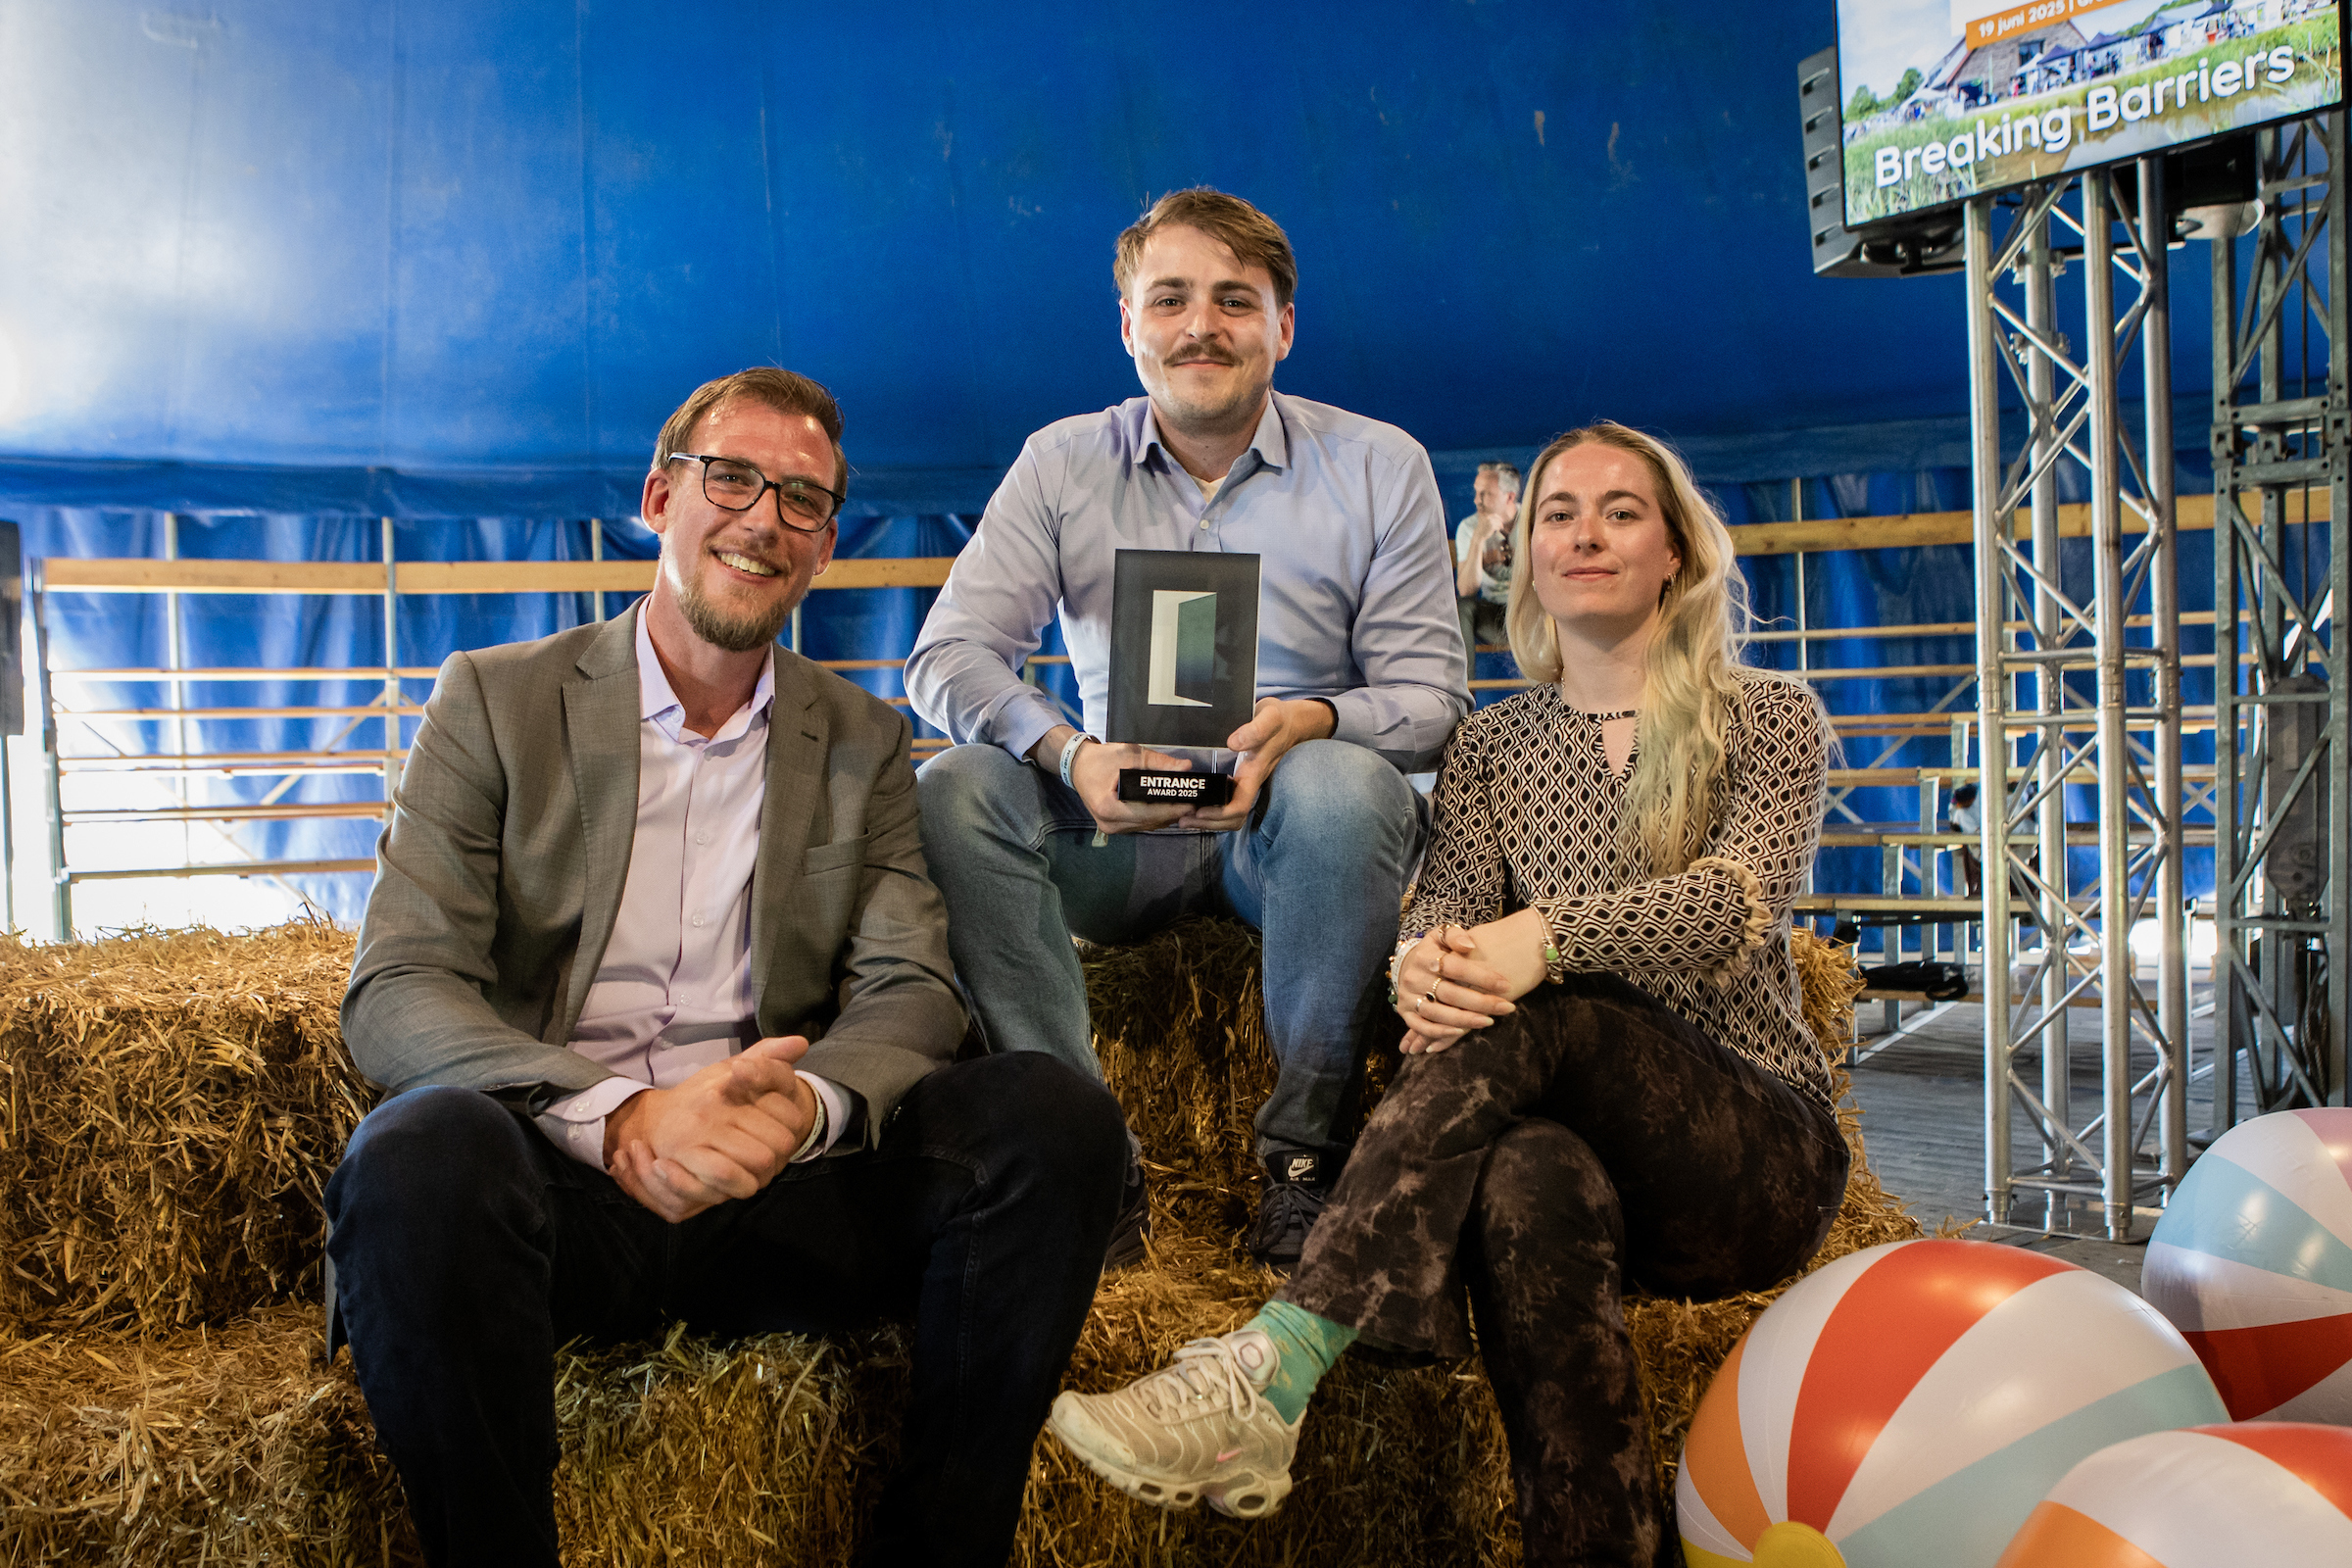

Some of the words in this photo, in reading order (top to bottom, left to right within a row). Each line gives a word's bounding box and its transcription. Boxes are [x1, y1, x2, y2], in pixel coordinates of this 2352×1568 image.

[1979, 20, 1995, 38] 19
[1997, 10, 2026, 37] juni
[2028, 0, 2066, 24] 2025
[1874, 103, 2073, 189] Breaking
[2086, 44, 2295, 133] Barriers
[1140, 775, 1206, 790] ENTRANCE
[1147, 788, 1177, 797] AWARD
[1178, 789, 1199, 798] 2025
[1292, 1157, 1314, 1168] NIKE
